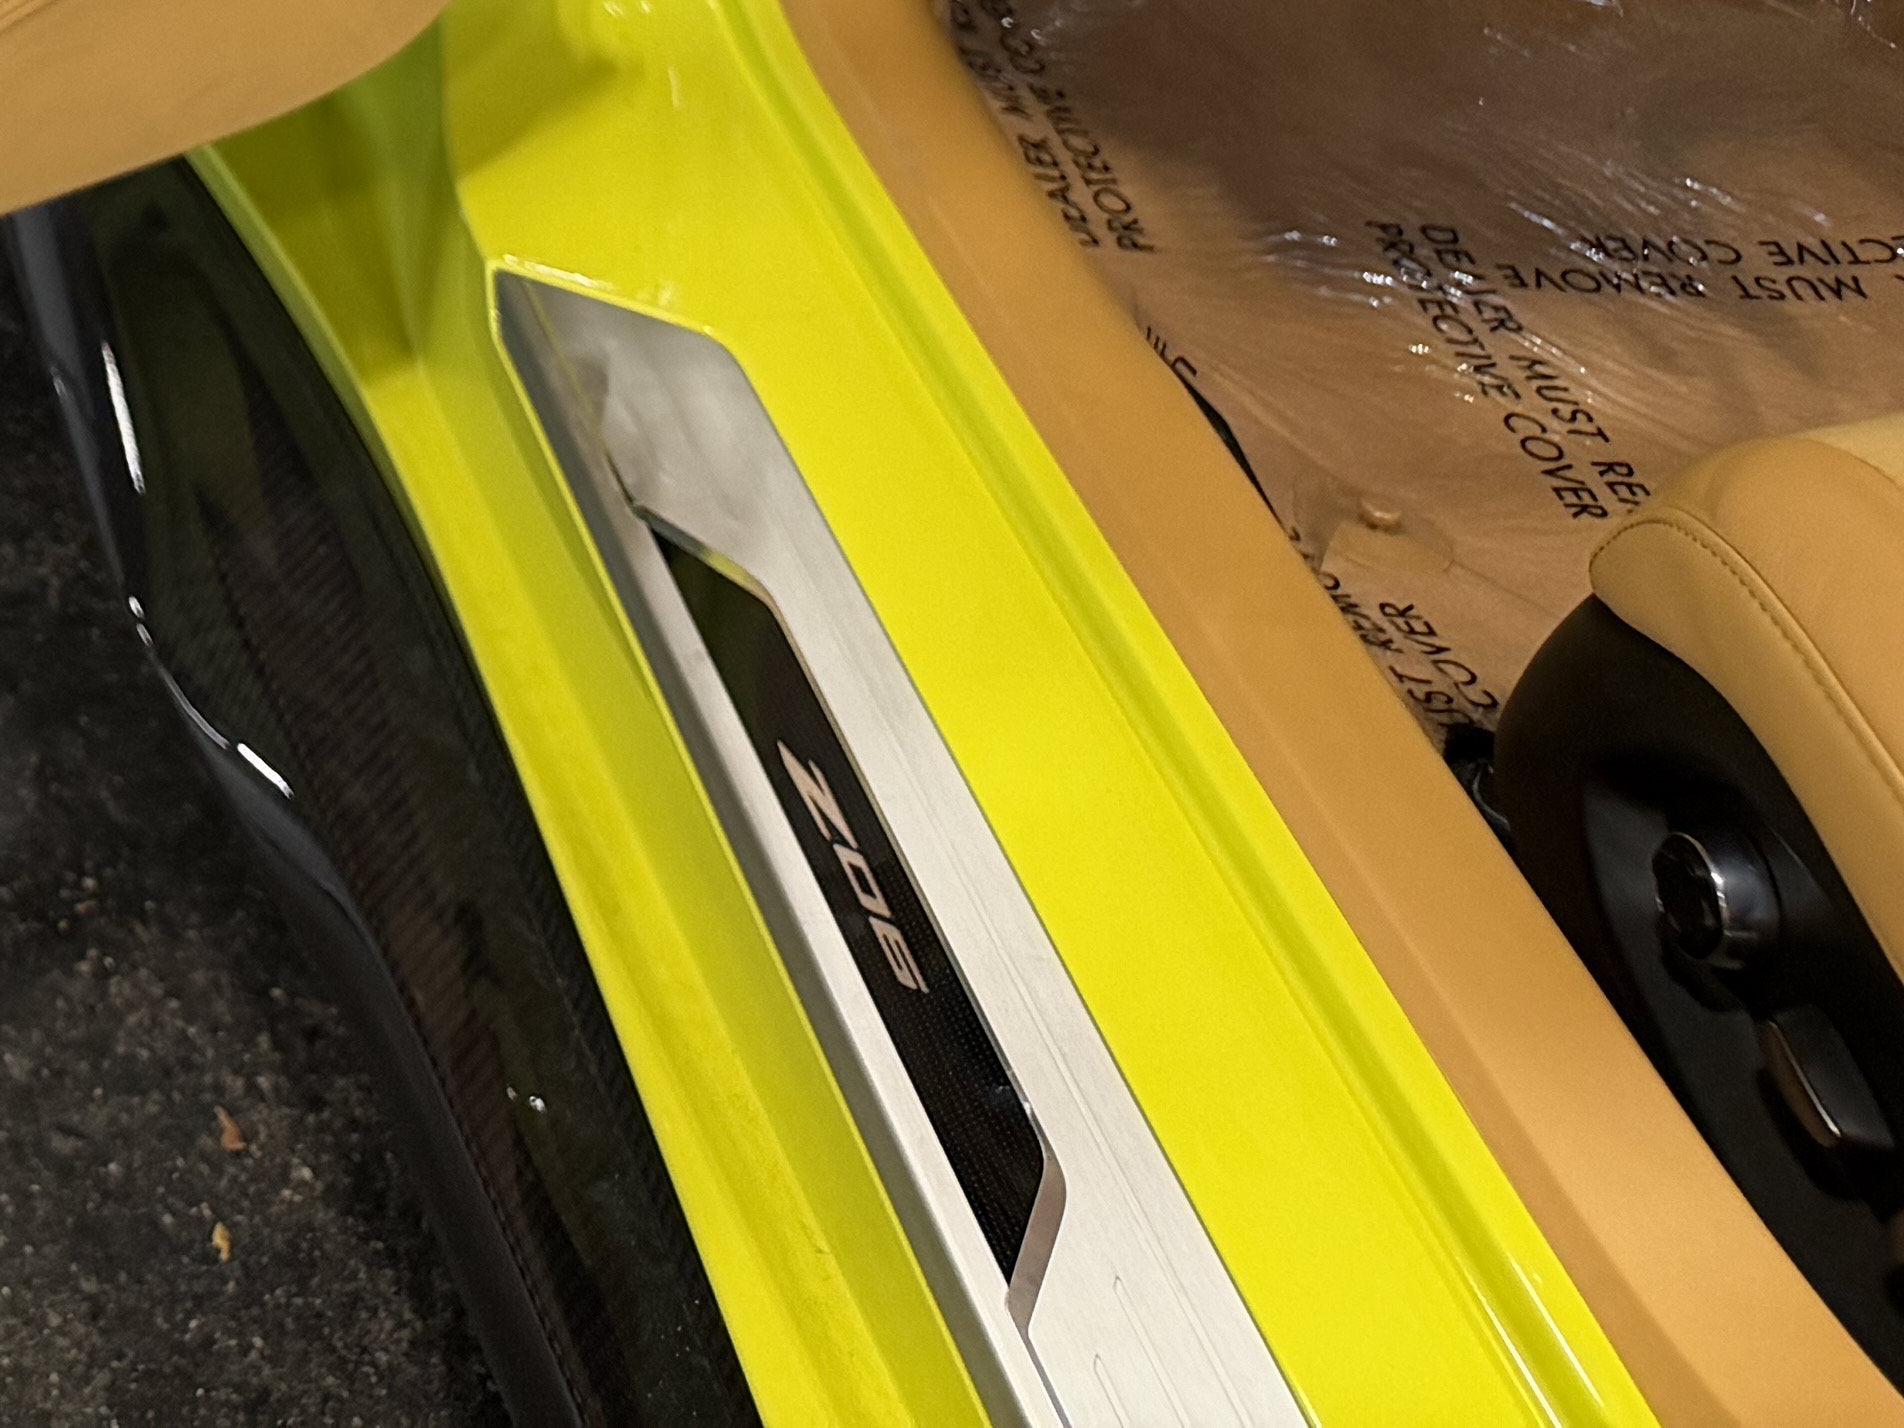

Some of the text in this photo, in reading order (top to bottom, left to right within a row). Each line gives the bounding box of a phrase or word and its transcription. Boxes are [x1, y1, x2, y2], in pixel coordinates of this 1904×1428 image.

[1495, 262, 1869, 302] MUST REMOVE
[1583, 232, 1743, 268] COVER
[1508, 353, 1610, 444] MUST
[1502, 410, 1609, 520] COVER
[1379, 601, 1500, 710] COVER
[1388, 664, 1478, 726] UST
[777, 738, 931, 994] Z06
